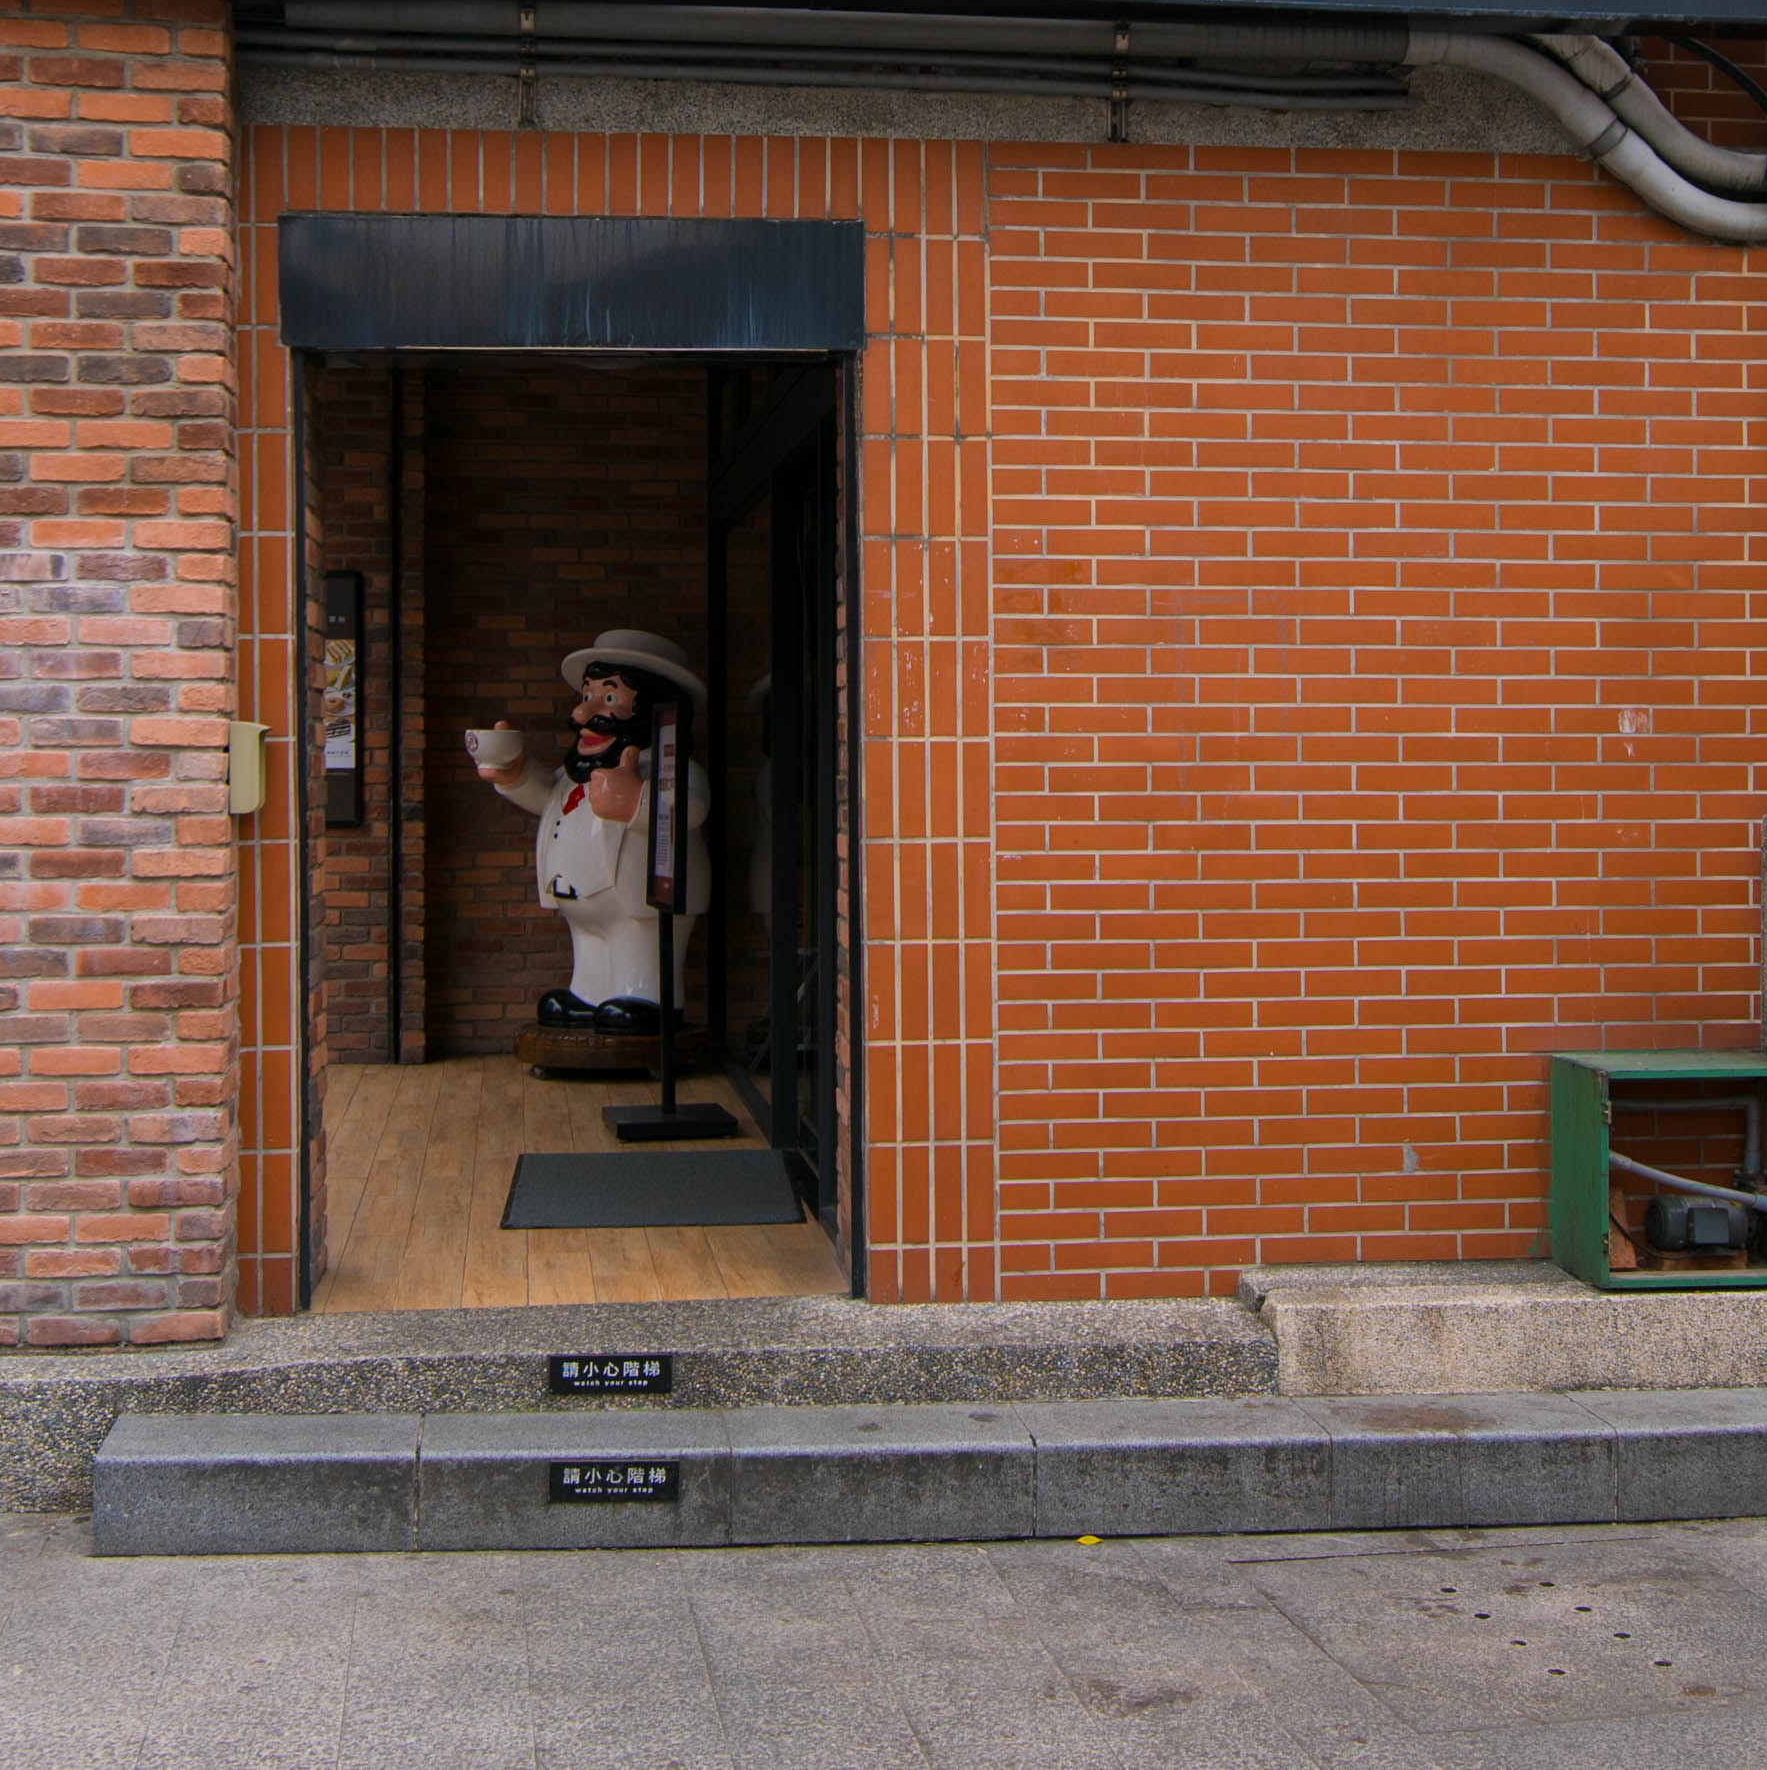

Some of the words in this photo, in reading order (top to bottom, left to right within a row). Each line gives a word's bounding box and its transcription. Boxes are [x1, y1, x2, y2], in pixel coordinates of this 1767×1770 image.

[562, 1361, 661, 1378] 請小心階梯
[562, 1467, 667, 1485] 請小心階梯
[575, 1486, 602, 1494] watch
